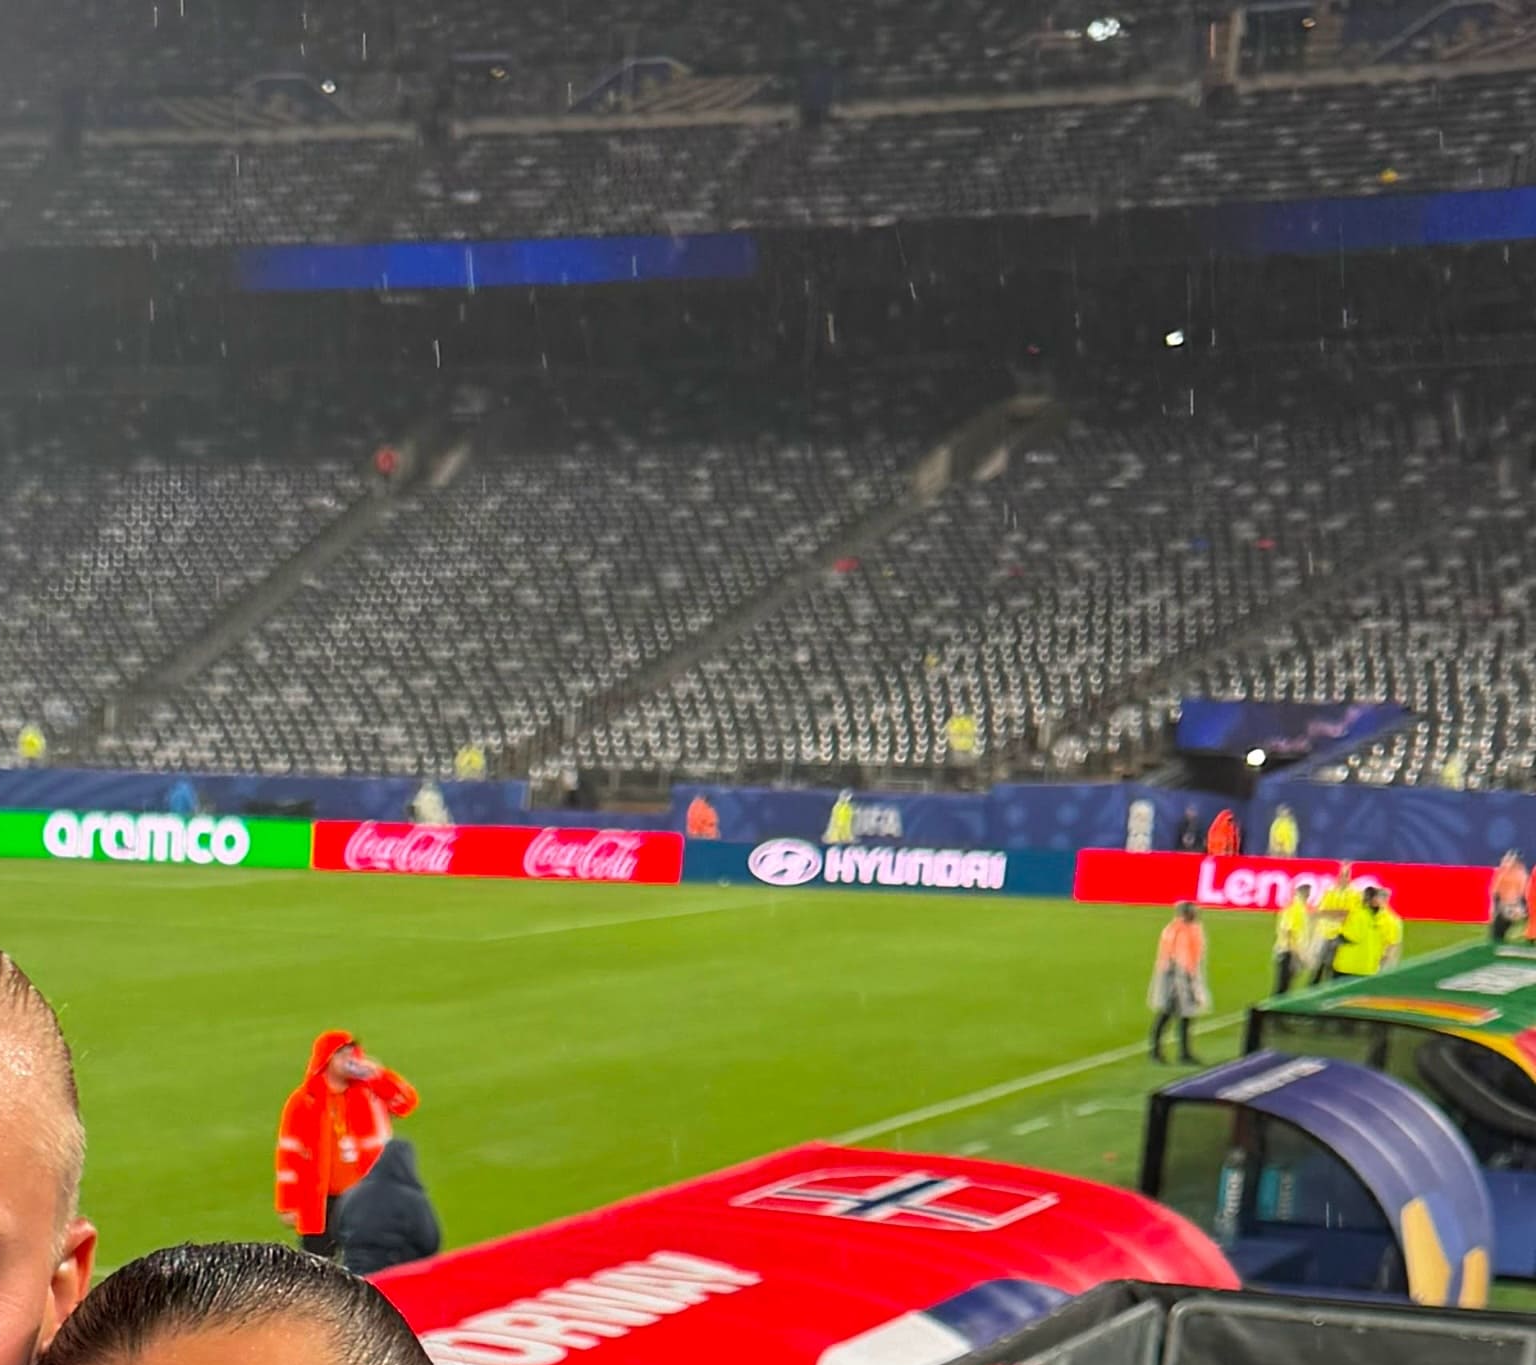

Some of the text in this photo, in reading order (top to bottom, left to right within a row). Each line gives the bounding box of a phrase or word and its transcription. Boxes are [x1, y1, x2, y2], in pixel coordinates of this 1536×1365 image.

[43, 809, 251, 866] aramco
[344, 818, 458, 873] Coca-Cola
[523, 825, 642, 880] Coca-Cola
[824, 845, 1006, 890] HYUNDAI
